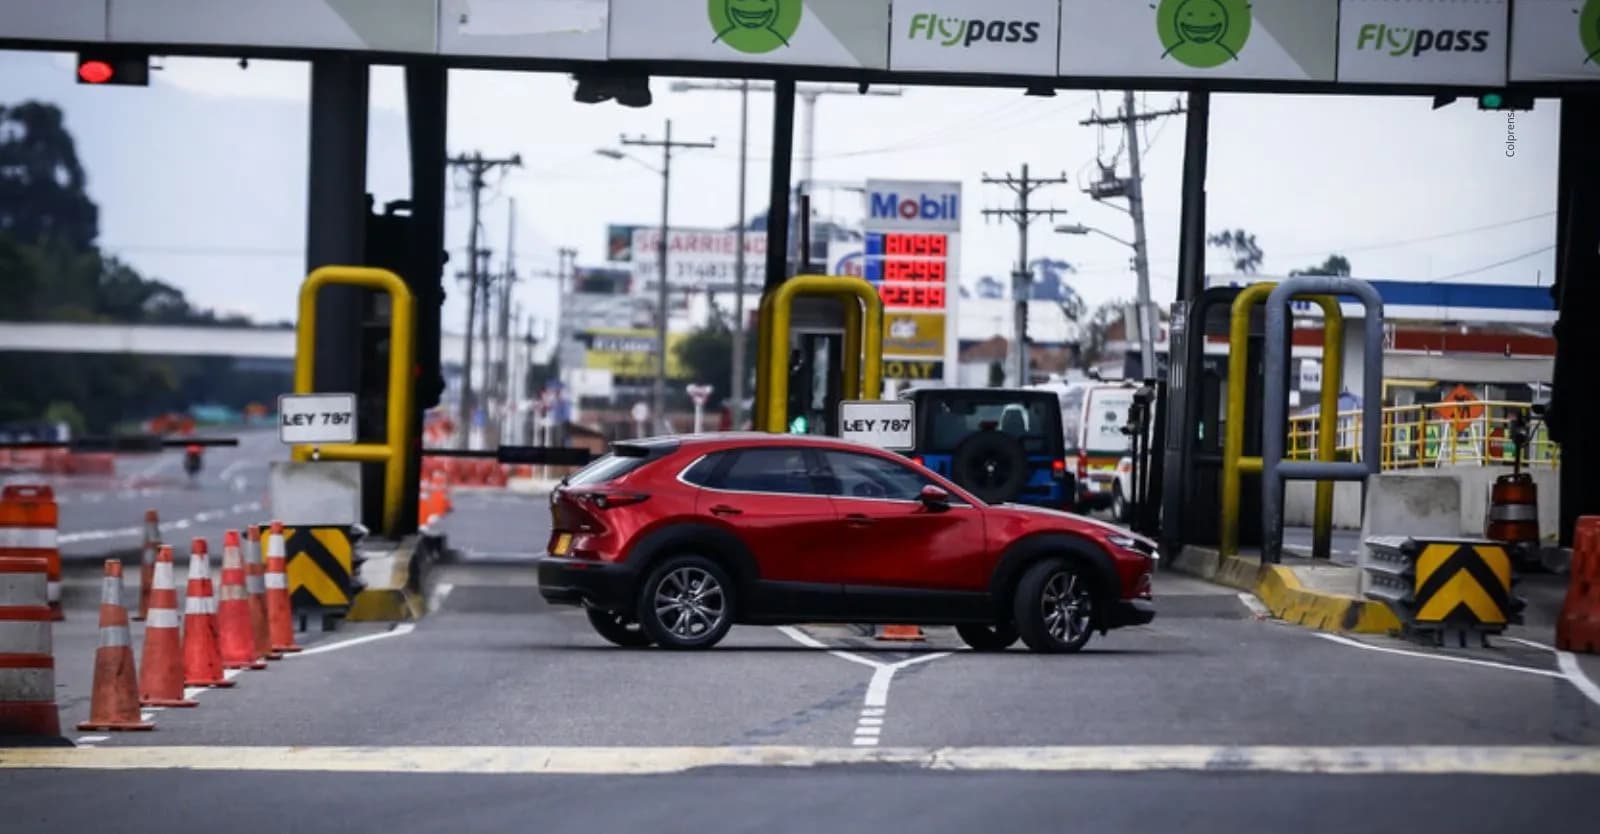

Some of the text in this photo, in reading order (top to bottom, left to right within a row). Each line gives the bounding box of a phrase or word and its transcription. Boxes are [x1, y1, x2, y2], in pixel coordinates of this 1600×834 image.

[908, 13, 1040, 47] Flypass
[1357, 23, 1489, 57] Flypass
[871, 191, 957, 219] Mobil
[282, 413, 315, 426] LEY
[843, 419, 910, 432] LEY 787
